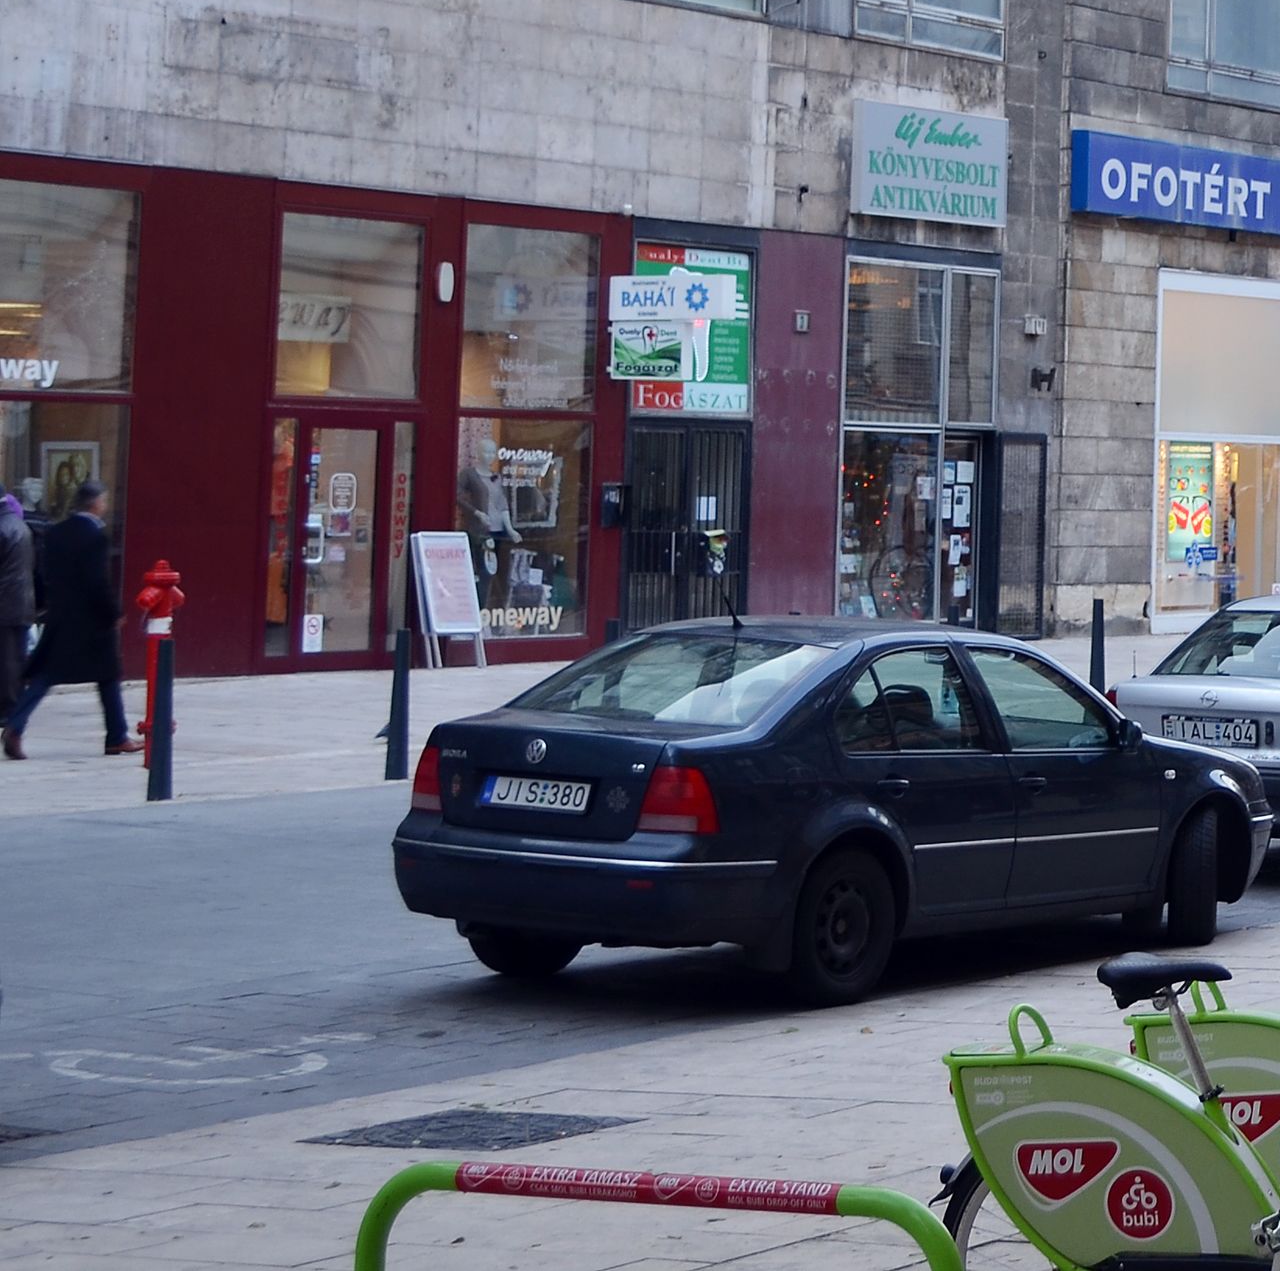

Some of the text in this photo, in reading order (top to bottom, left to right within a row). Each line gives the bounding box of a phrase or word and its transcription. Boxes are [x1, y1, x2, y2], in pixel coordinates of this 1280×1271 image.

[894, 112, 982, 149] Új Ember
[867, 145, 1000, 188] KÖNYVESBOLT
[869, 184, 998, 220] ANTIKVÁRIUM
[1100, 158, 1272, 220] OFOTÉRT
[615, 361, 681, 375] Fogászat
[637, 383, 747, 409] FOGÁSZAT
[393, 473, 408, 558] oneway
[478, 605, 563, 630] oneway
[530, 1166, 578, 1183] EXTRA
[1028, 1148, 1086, 1175] MOL
[727, 1178, 833, 1197] EXTRA STAND
[727, 1195, 745, 1205] MOL
[806, 1199, 828, 1209] ONLY
[1122, 1211, 1160, 1227] bubi
